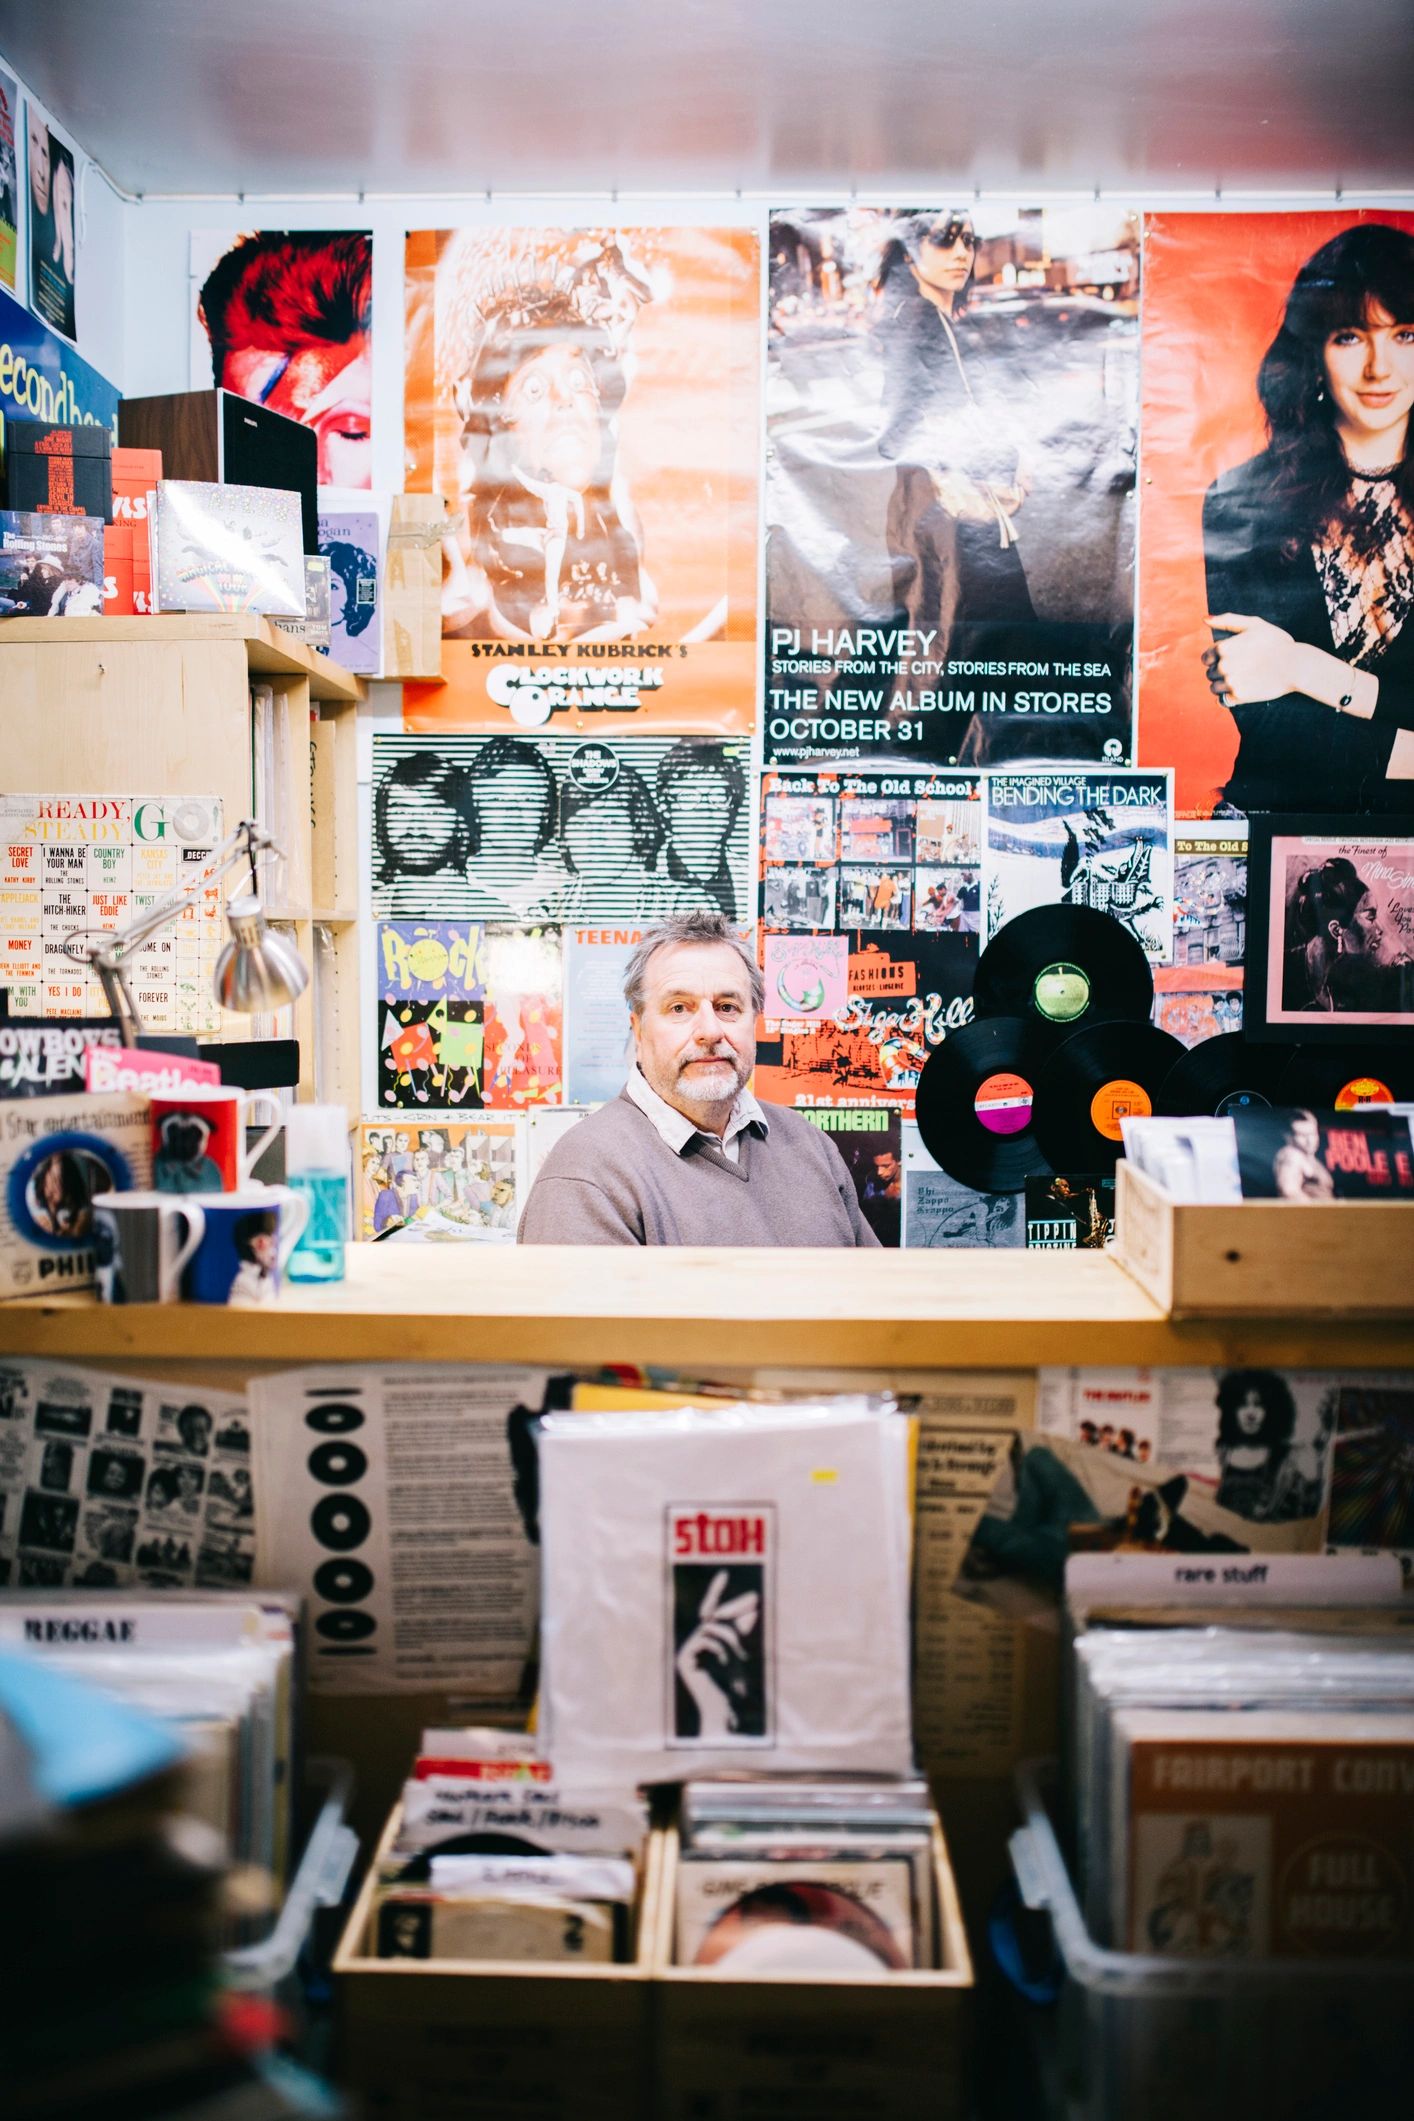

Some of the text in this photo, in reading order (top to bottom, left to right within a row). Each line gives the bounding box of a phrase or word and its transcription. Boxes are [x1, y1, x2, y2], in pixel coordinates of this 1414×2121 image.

[3, 539, 68, 553] Rolling Stones
[772, 628, 938, 657] PJ HARVEY
[471, 643, 571, 658] STANLEY
[772, 660, 1112, 677] STORIES FROM THE CITY, STORIES FROM THE SEA
[486, 663, 664, 707] CLOCKWORK
[509, 685, 642, 727] ORANGE
[769, 689, 1112, 714] THE NEW ALBUM IN STORES
[769, 718, 924, 741] OCTOBER 31
[772, 745, 860, 760] www.pjharvey.net
[571, 758, 617, 768] SHADOWS
[769, 778, 973, 796] Back To The Old School
[991, 776, 1087, 787] THE IMAGINED VILLAGE
[991, 785, 1164, 807] BENDING THE DARK
[1176, 840, 1193, 852] To
[1195, 840, 1217, 852] The
[1219, 840, 1239, 852] Old
[1338, 844, 1388, 859] the Finest of
[8, 847, 34, 858] SECRET
[43, 847, 87, 858] I WANNA BE
[93, 848, 125, 859] COUNTRY
[186, 851, 207, 861] DECC
[11, 858, 29, 868] LOVE
[46, 858, 84, 869] YOUR MAN
[102, 859, 117, 870] BOY
[45, 877, 85, 885] ROLLING STONES
[58, 893, 72, 905] THE
[92, 895, 128, 906] JUST LIKE
[135, 895, 156, 906] TWIST
[43, 905, 87, 916] HITCH-HIKER
[100, 905, 119, 916] EDDIE
[50, 923, 59, 931] THE
[576, 930, 643, 945] TEENA
[8, 939, 33, 950] MONEY
[140, 942, 172, 953] OME ON
[48, 967, 56, 975] THE
[139, 965, 170, 973] THE ROLLING
[20, 986, 37, 997] WITH
[47, 986, 82, 997] YES I DO
[14, 997, 29, 1008] YOU
[138, 992, 169, 1003] FOREVER
[832, 992, 976, 1046] Sugar Hill
[797, 1110, 889, 1131] ORTHERN
[1027, 1223, 1077, 1240] TIPPIN
[1175, 1565, 1268, 1584] rare stuff
[23, 1618, 136, 1643] REGGAE
